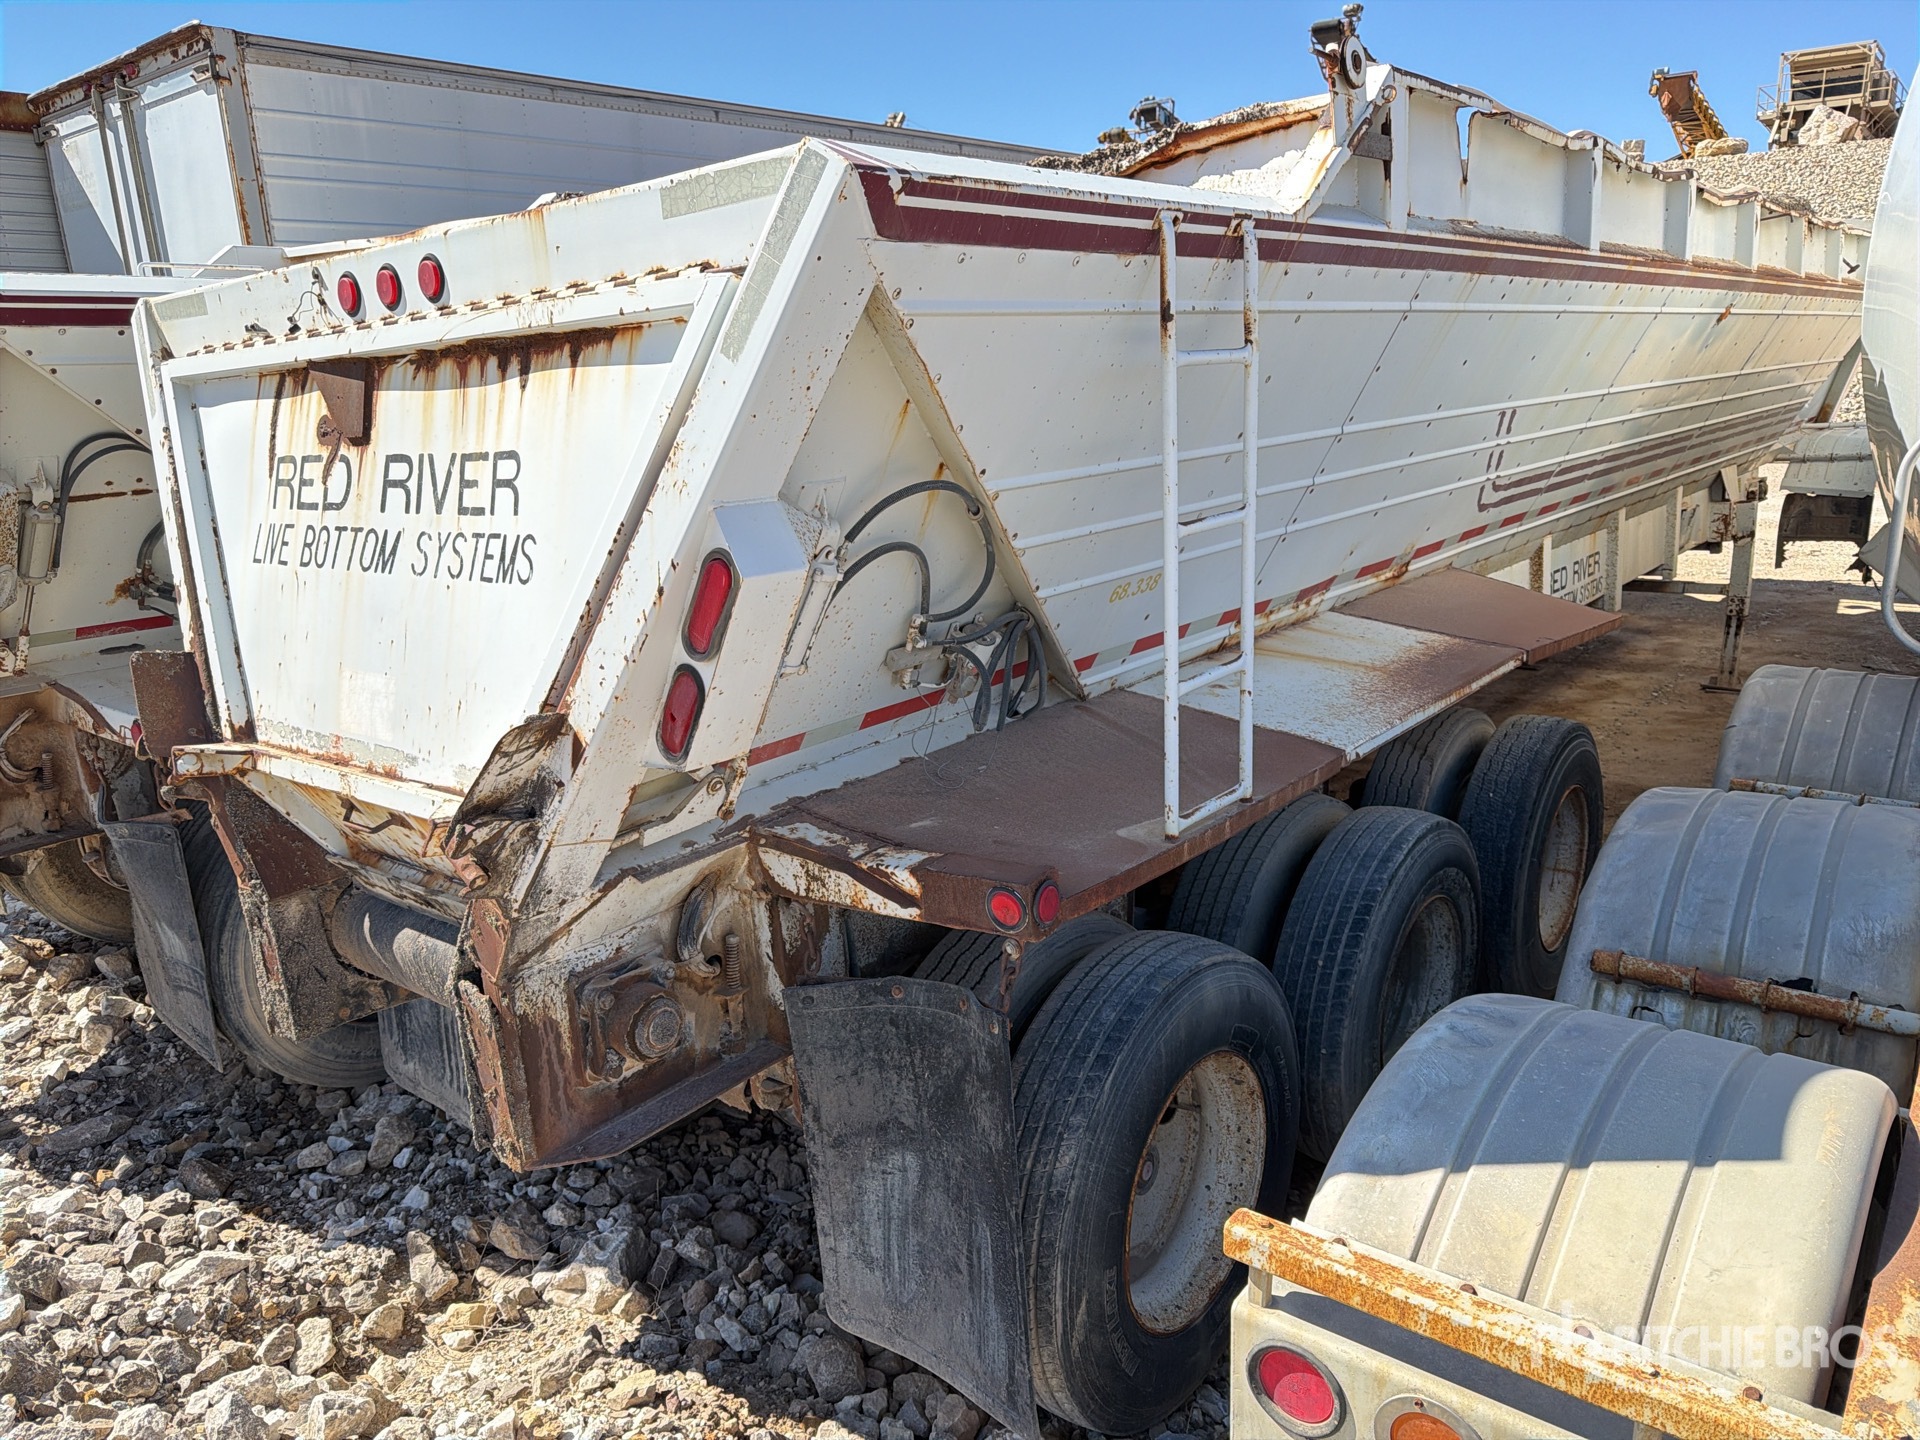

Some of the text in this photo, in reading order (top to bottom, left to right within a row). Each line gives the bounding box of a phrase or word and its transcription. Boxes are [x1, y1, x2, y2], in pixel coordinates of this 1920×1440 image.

[273, 450, 521, 516] RED RIVER
[252, 523, 537, 585] LIVE BOTTOM SYSTEMS
[1572, 551, 1600, 585] RIVER
